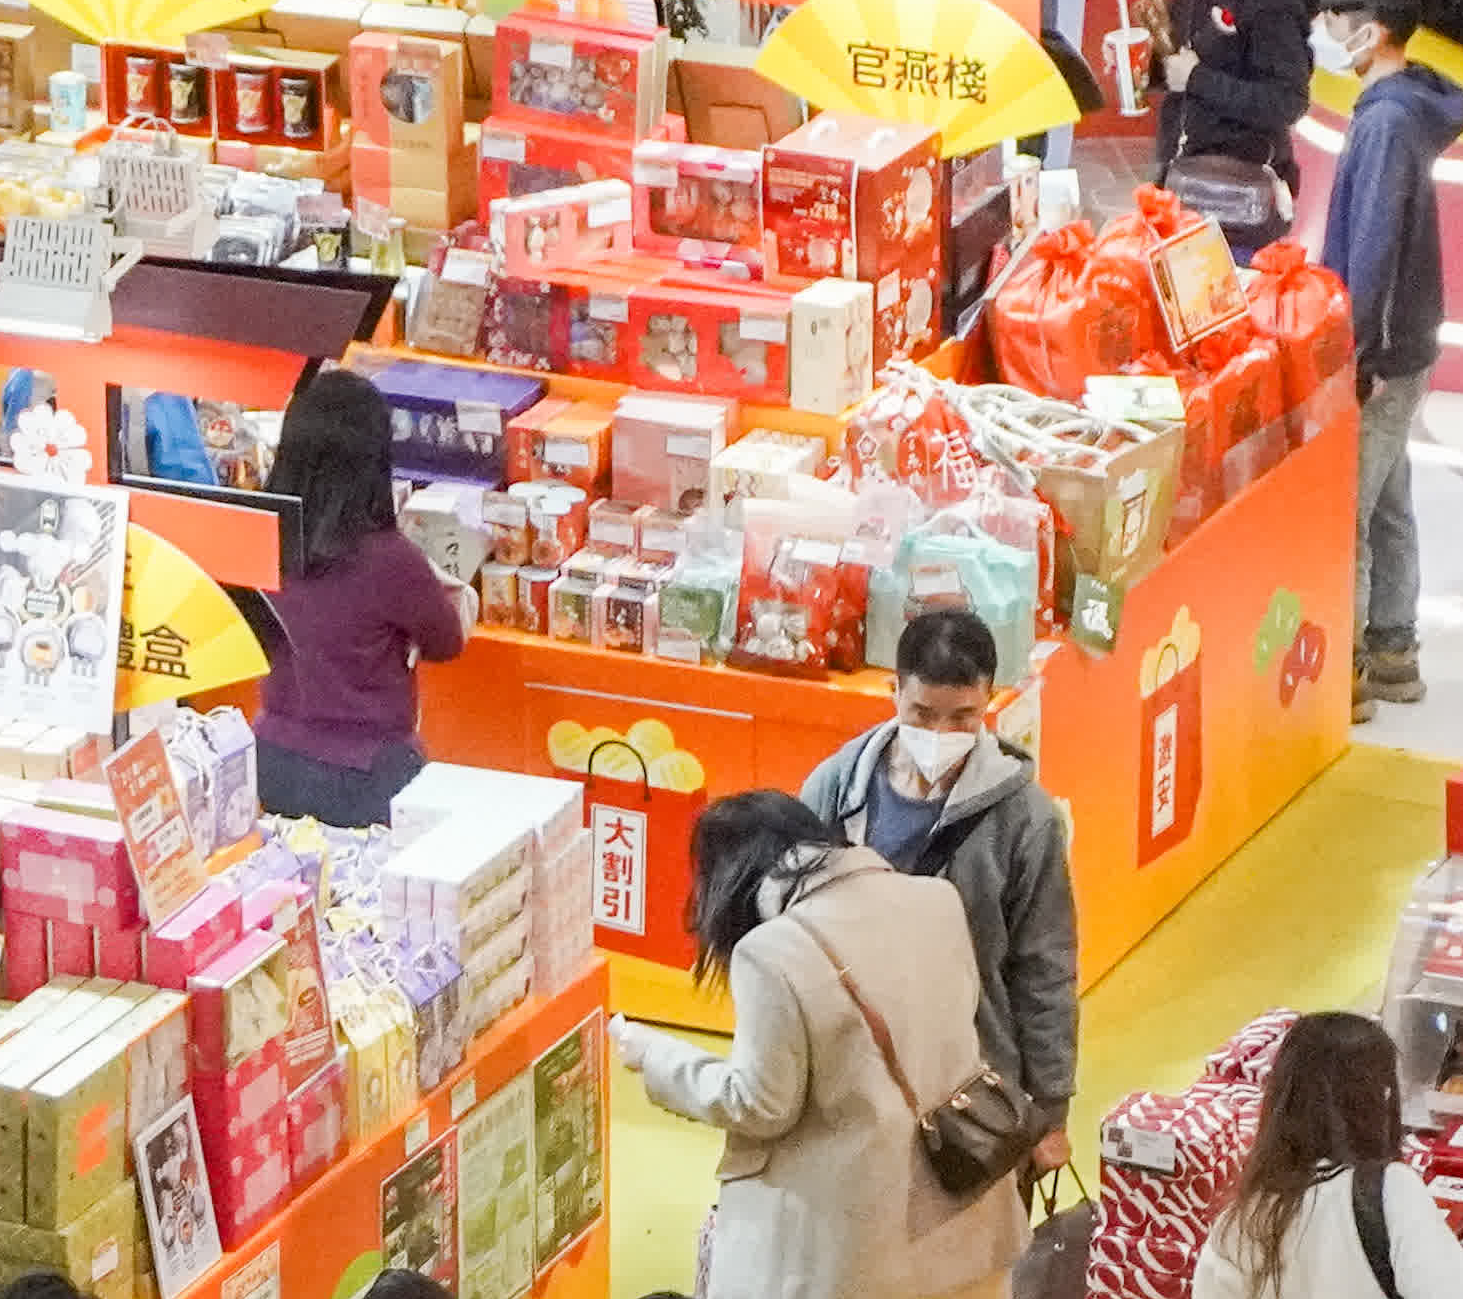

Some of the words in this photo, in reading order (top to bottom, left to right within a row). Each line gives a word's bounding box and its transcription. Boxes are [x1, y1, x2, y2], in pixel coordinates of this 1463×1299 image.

[846, 40, 990, 106] 官燕棧
[929, 430, 977, 491] 福
[602, 817, 637, 923] 大割引
